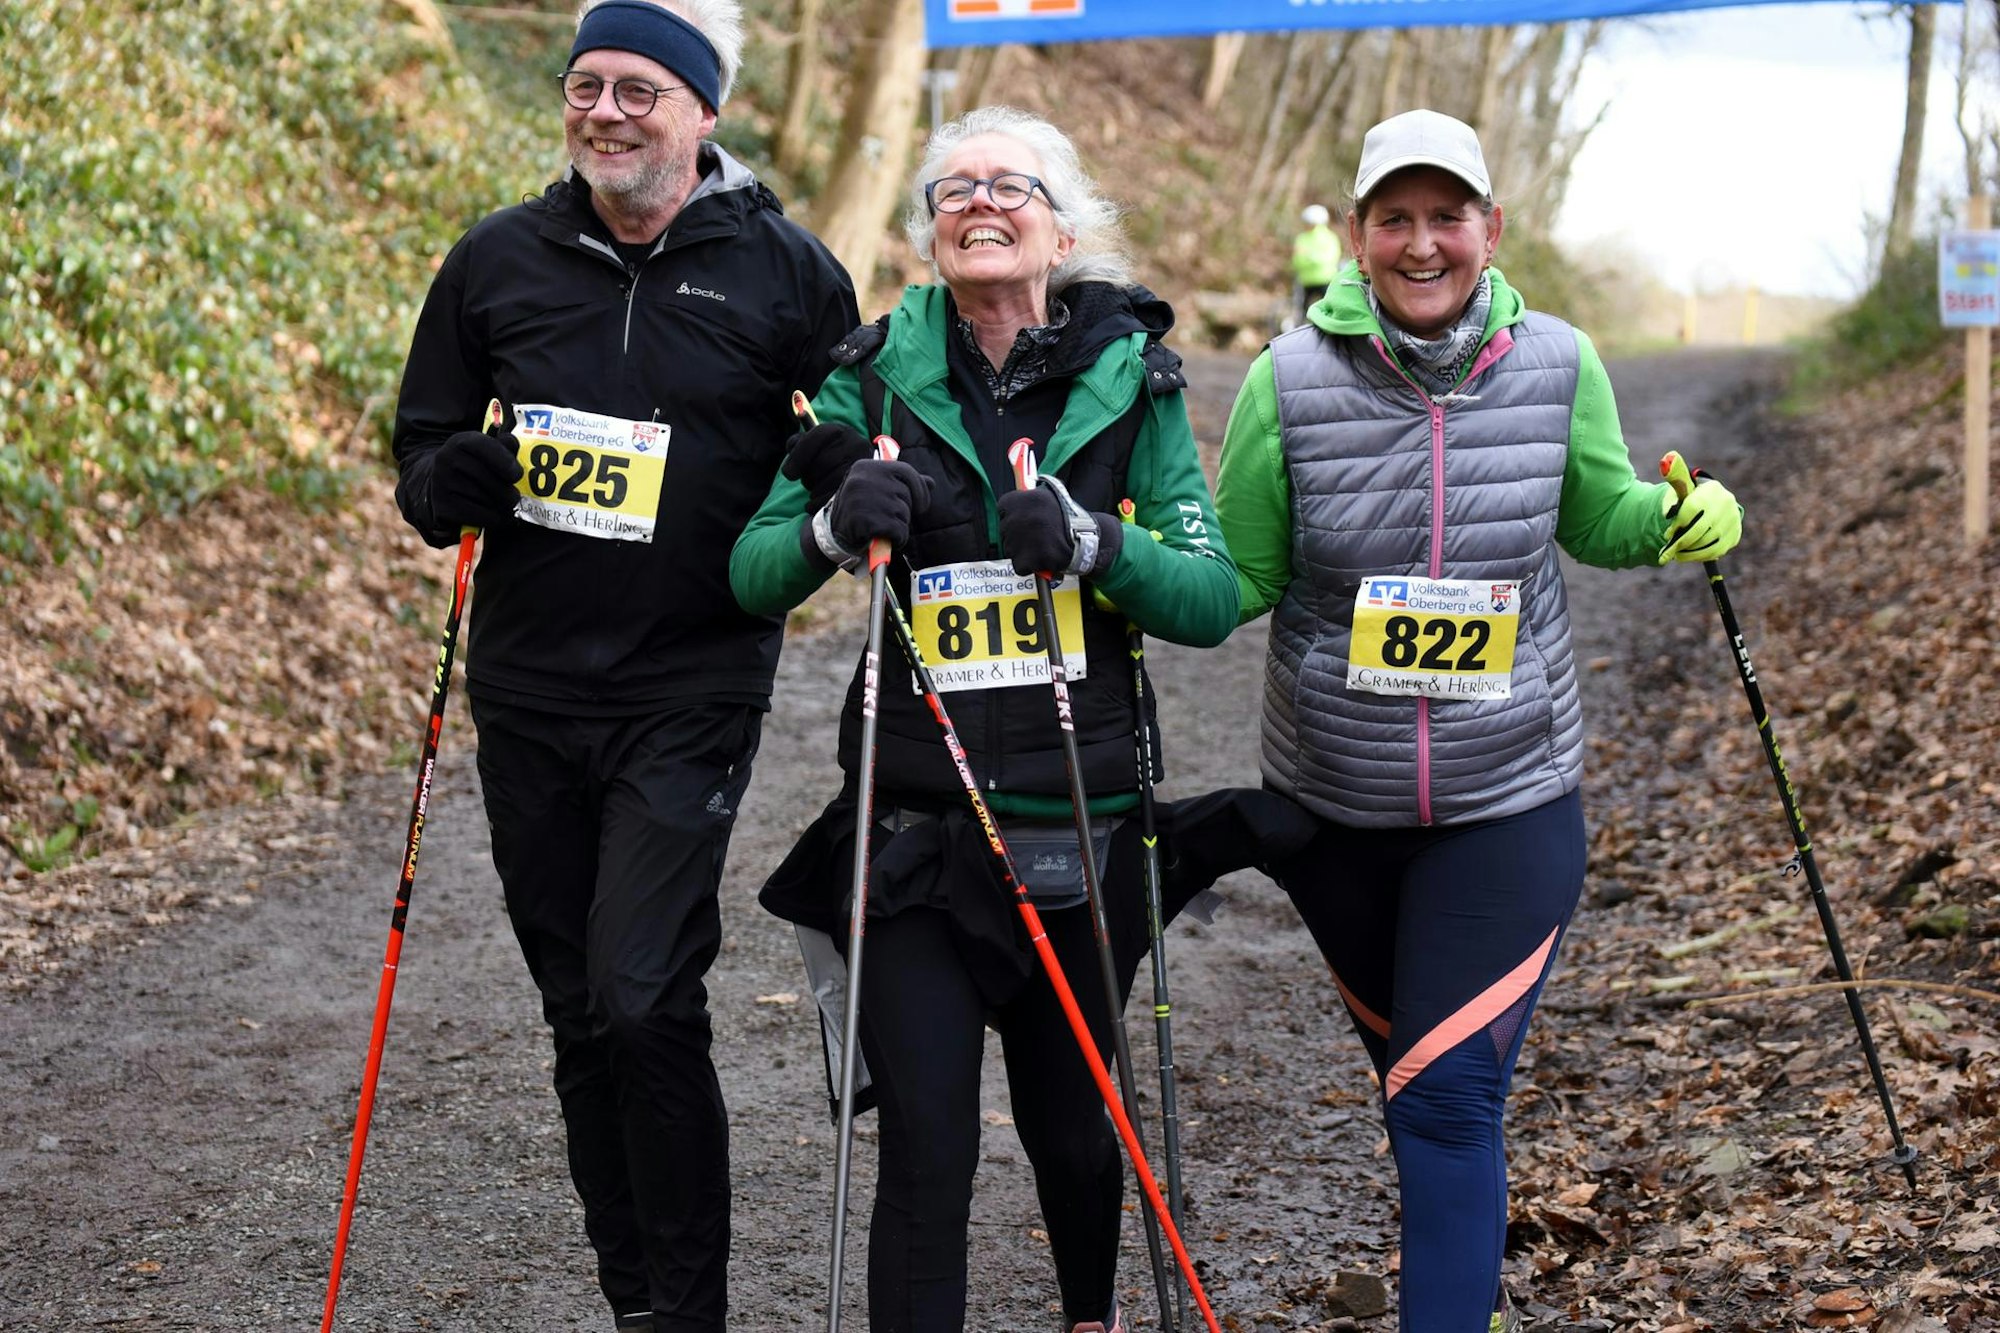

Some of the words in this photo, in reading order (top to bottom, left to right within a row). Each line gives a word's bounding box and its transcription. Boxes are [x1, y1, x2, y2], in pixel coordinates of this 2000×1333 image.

[1944, 290, 1995, 312] Start
[554, 412, 610, 430] Volksbank
[551, 426, 605, 447] Oberberg
[607, 436, 625, 447] eG
[528, 444, 630, 508] 825
[566, 508, 578, 526] &
[953, 567, 1015, 580] Volksbank
[954, 581, 1013, 595] Oberberg
[1017, 579, 1034, 590] eG
[1411, 582, 1470, 597] Volksbank
[1408, 597, 1466, 614] Oberberg
[1469, 601, 1484, 612] eG
[937, 598, 1047, 660] 819
[1381, 615, 1491, 671] 822
[1733, 633, 1758, 684] LEKI
[990, 663, 1004, 680] &
[1358, 668, 1423, 688] CRAMER
[1428, 675, 1441, 692] &
[863, 652, 879, 718] LEKI
[1051, 664, 1075, 732] LEKI
[416, 757, 435, 816] WALKER
[944, 733, 974, 790] WALKER
[968, 787, 1004, 855] PLATINUM
[404, 813, 425, 882] PLATINUM
